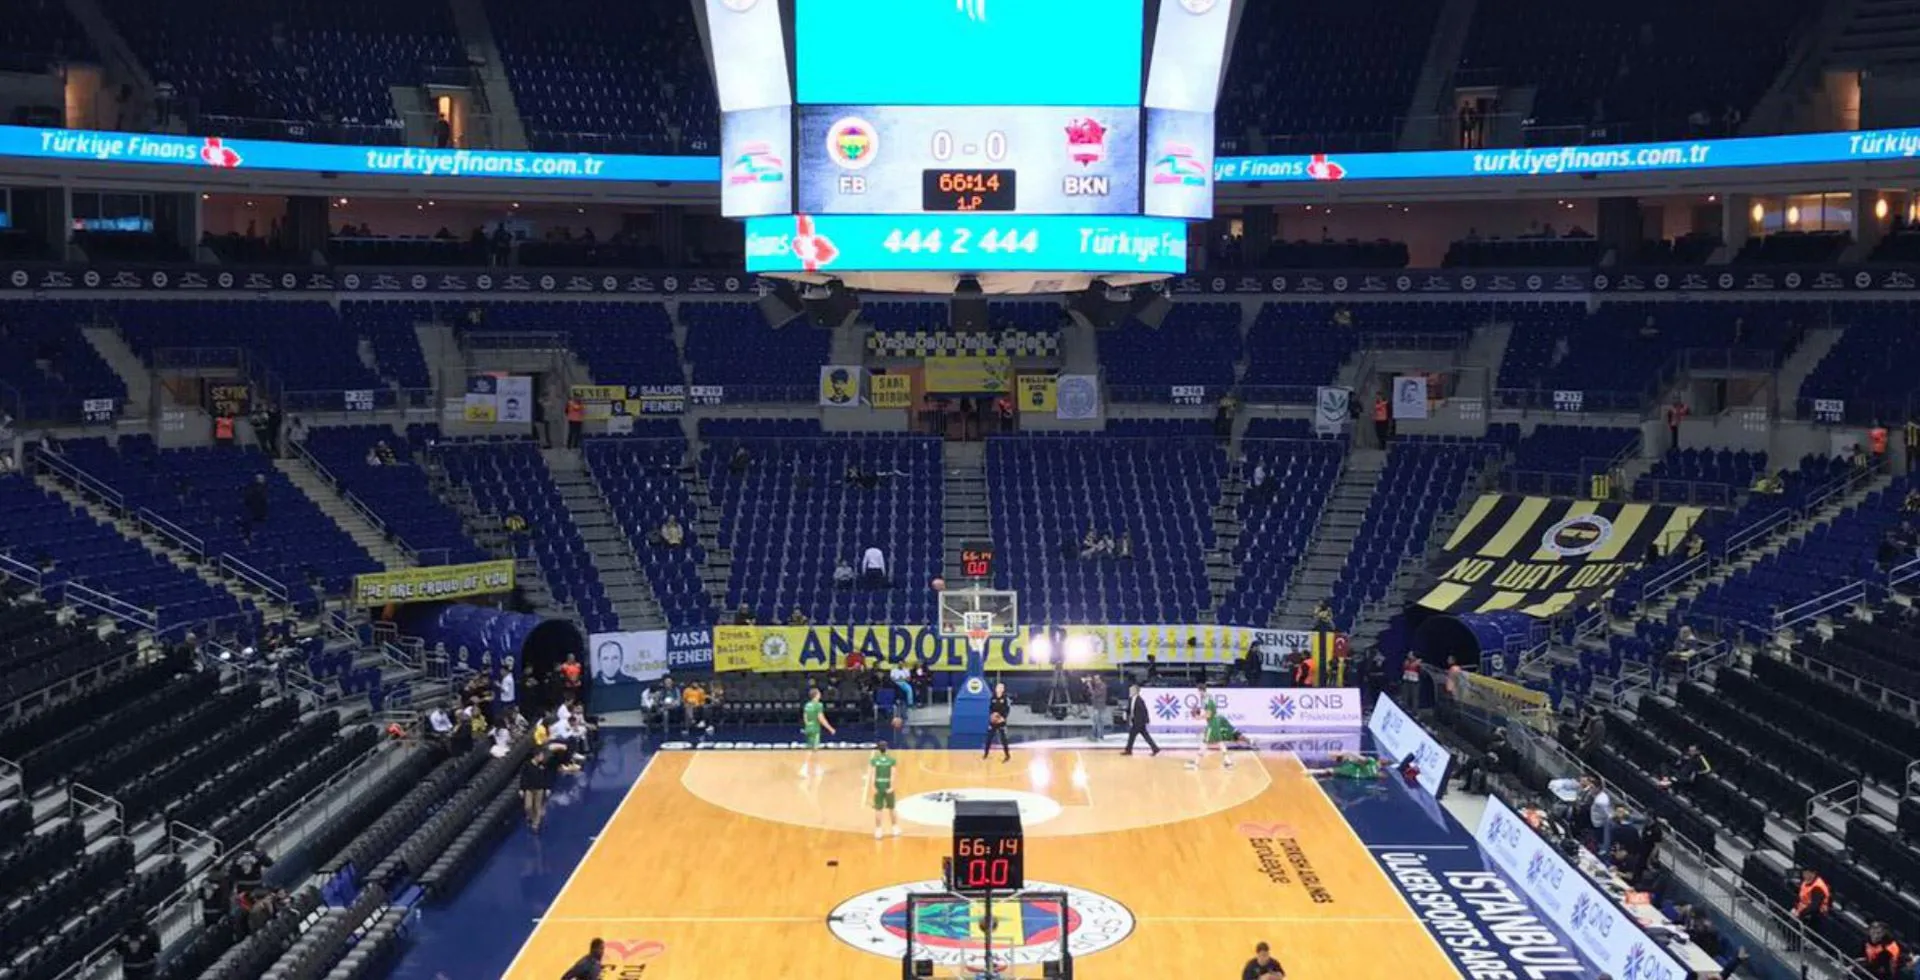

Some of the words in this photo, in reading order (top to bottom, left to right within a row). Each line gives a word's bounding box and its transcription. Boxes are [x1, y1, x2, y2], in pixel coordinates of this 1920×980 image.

[40, 131, 123, 160] Türkiye
[127, 137, 197, 160] Finans
[932, 130, 953, 161] 0
[985, 130, 1007, 161] 0
[366, 148, 605, 176] turkiyefinans.com.tr
[1240, 159, 1304, 177] Finans
[1473, 144, 1711, 175] turkiyefinans.com.tr
[838, 177, 867, 194] FB
[939, 173, 1000, 193] 66:14
[1063, 177, 1110, 195] BKN
[956, 197, 983, 211] 1.P
[883, 228, 943, 254] 444
[949, 228, 971, 253] 2
[979, 228, 1039, 253] 444
[1079, 227, 1160, 263] Türkiye
[641, 400, 684, 412] FENER
[389, 583, 415, 598] ARE
[418, 578, 460, 596] PROUD
[462, 575, 482, 589] OF
[483, 572, 509, 587] YOU
[1437, 557, 1495, 583] NO
[1491, 559, 1567, 590] WAY
[668, 648, 712, 665] FENER
[1299, 693, 1344, 709] QNB
[959, 838, 1019, 856] 66:14
[968, 859, 1009, 885] 0.0
[1381, 851, 1444, 893] ÜLKER
[1412, 892, 1490, 947] SPORTS
[1443, 871, 1585, 980] ISTANBUL
[1587, 902, 1615, 939] QNB
[1643, 954, 1673, 980] QN
